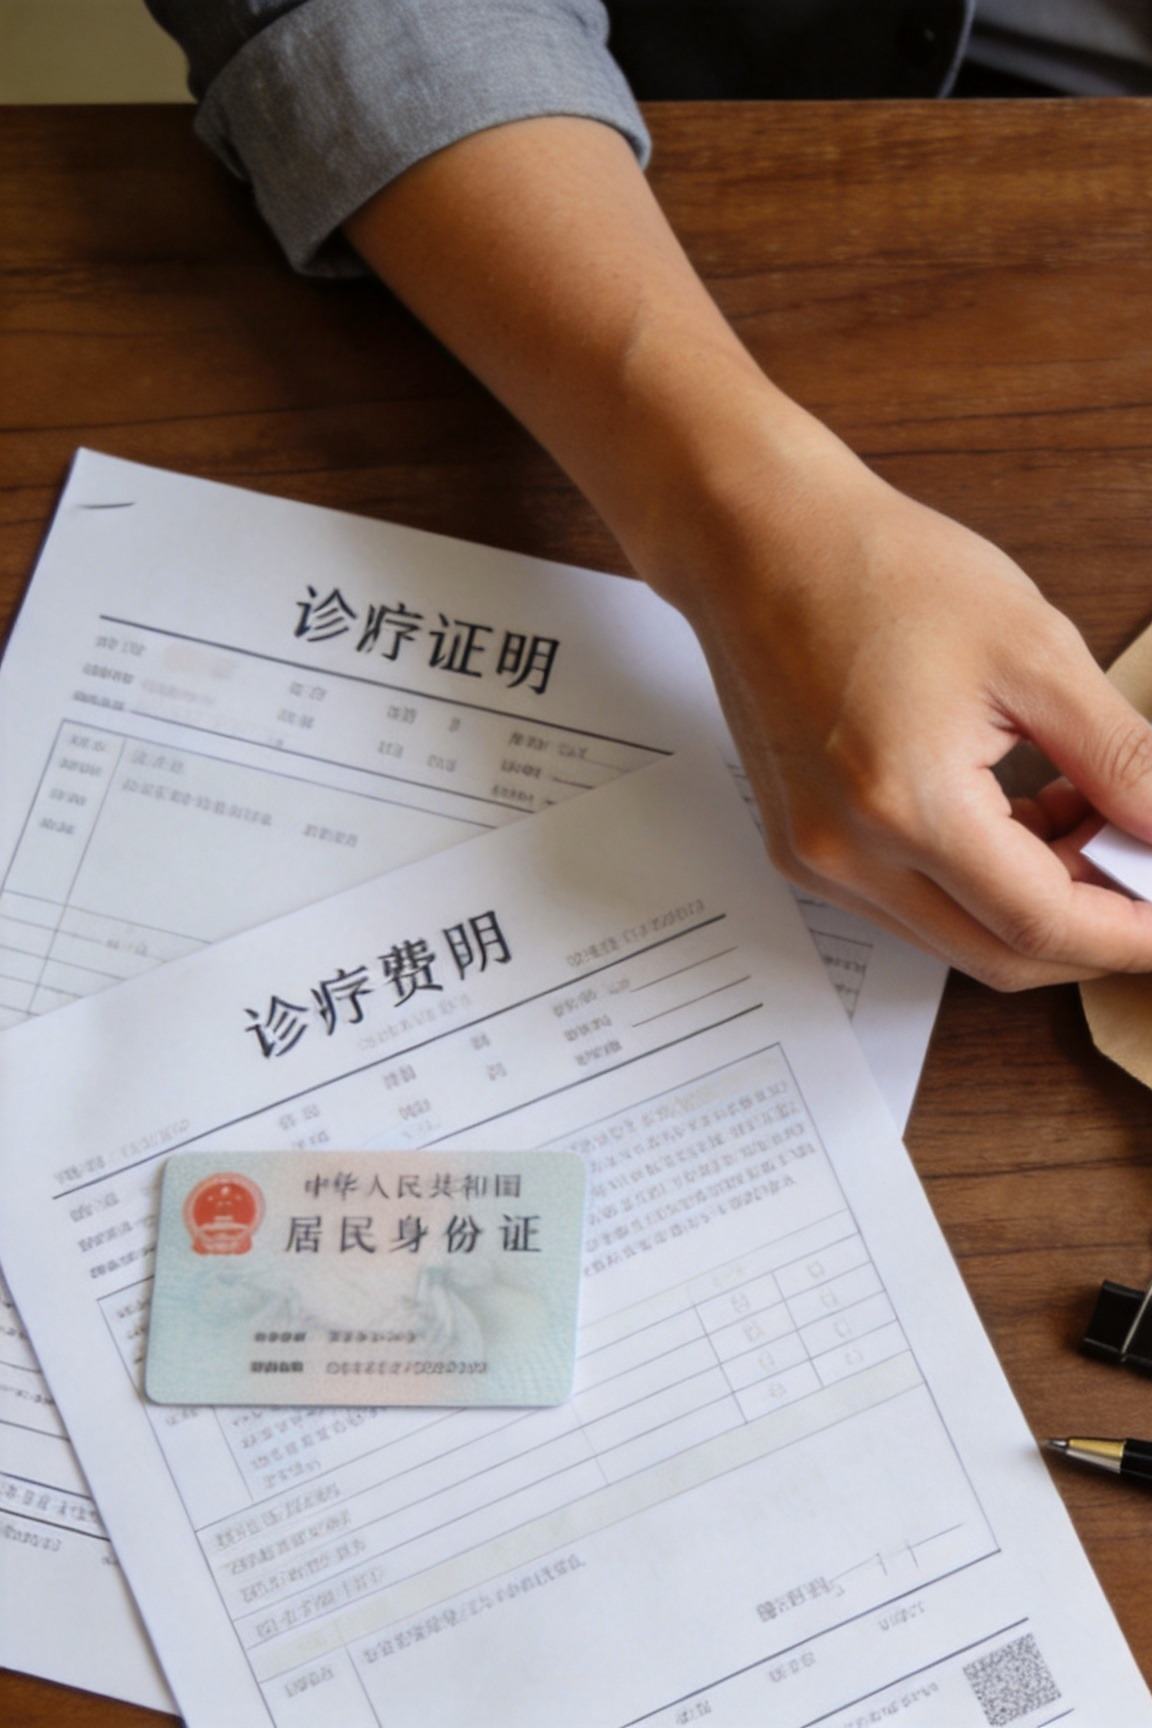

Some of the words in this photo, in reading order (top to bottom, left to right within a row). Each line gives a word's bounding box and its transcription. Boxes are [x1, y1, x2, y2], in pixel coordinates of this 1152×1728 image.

[296, 585, 560, 695] 诊疗证明
[244, 910, 512, 1058] 诊疗费明
[304, 1172, 521, 1200] 中华人民共和国
[286, 1214, 542, 1253] 居民身份证
